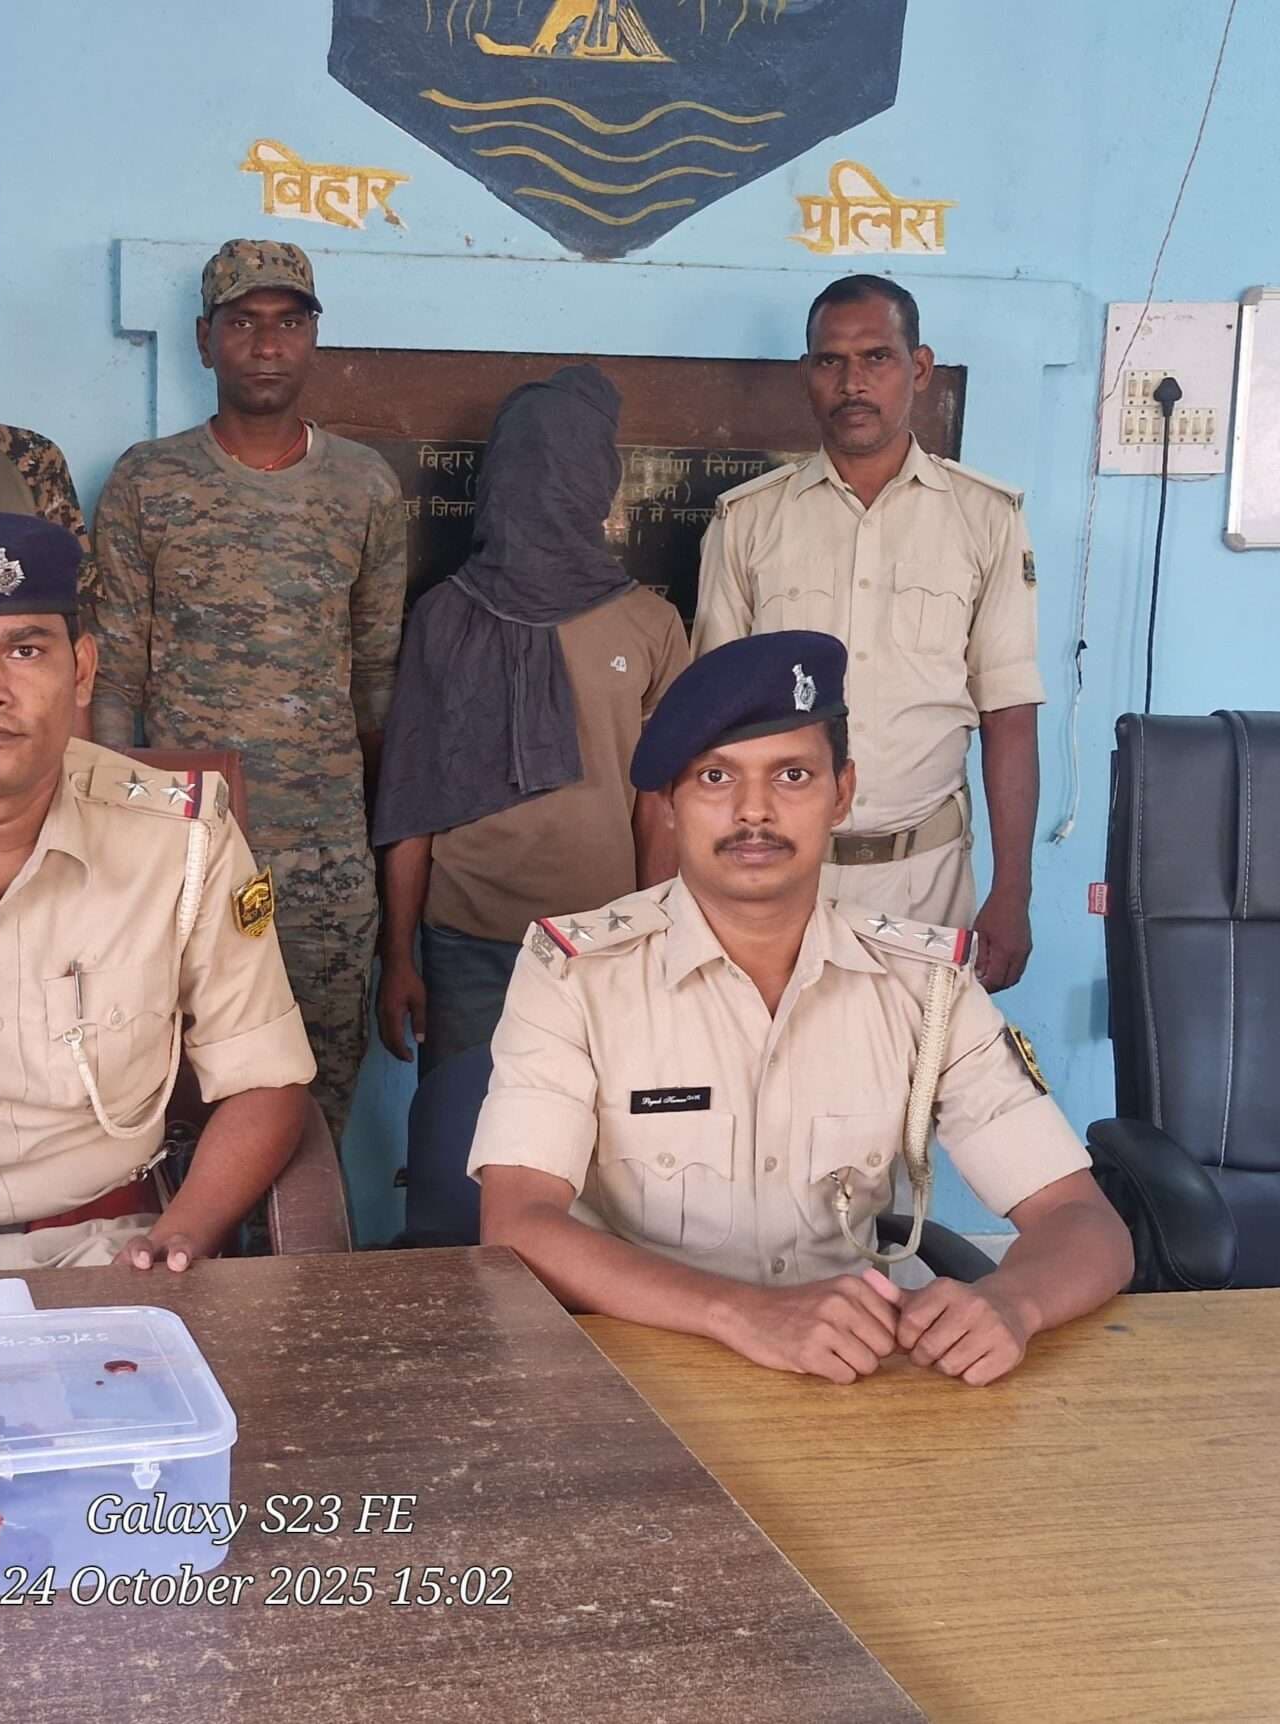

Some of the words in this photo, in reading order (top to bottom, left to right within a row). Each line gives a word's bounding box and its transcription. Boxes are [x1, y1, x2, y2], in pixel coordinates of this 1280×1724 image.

[238, 138, 412, 229] बिहार
[784, 160, 961, 254] पुलिस
[418, 445, 475, 475] बिहार
